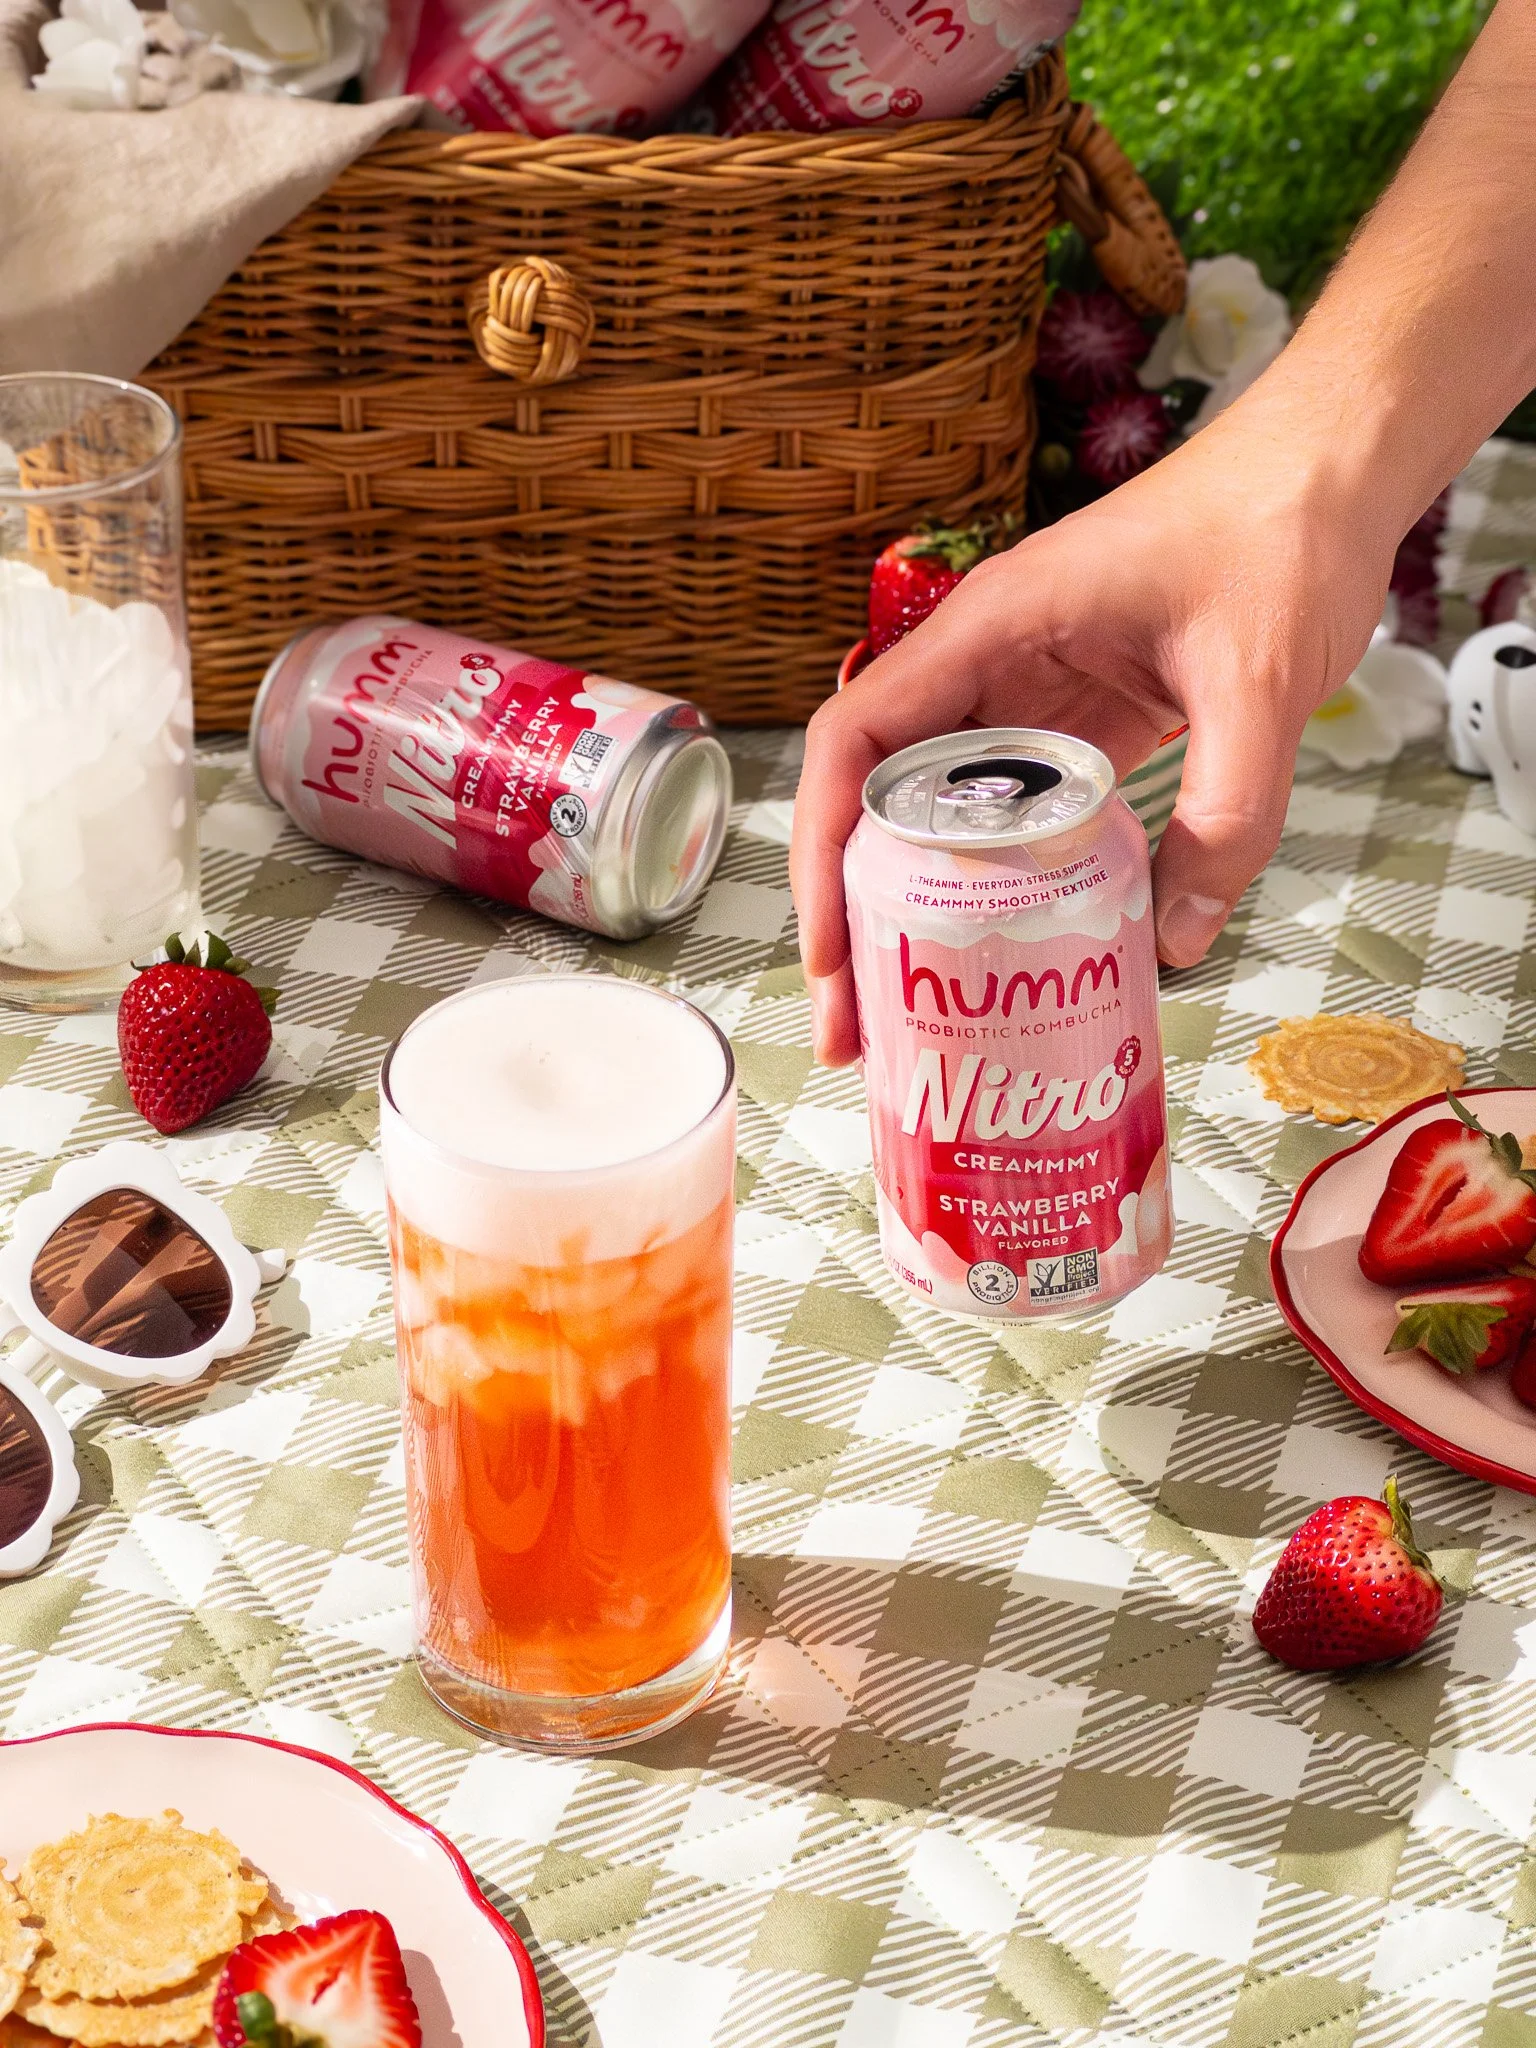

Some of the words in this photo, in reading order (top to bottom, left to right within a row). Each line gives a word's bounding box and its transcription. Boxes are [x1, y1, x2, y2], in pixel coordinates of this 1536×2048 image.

[302, 640, 419, 804] humm
[383, 667, 504, 850] Nitro
[496, 696, 560, 837] STRAWBERRY
[515, 723, 563, 812] VANILLA
[561, 808, 577, 824] 2
[972, 877, 1024, 891] EVERYDAY
[1026, 869, 1062, 885] STRESS
[1061, 853, 1100, 877] SUPPORT
[905, 892, 984, 909] CREAMMMY
[988, 890, 1051, 909] SMOOTH
[1052, 869, 1109, 899] TEXTURE
[900, 932, 1120, 1018] humm
[905, 1017, 1011, 1039] PROBIOTIC
[1020, 998, 1122, 1037] KOMBUCHA
[1123, 1048, 1135, 1067] 5
[901, 1047, 1127, 1143] Nitro
[953, 1149, 1100, 1175] CREAMMMY
[939, 1176, 1120, 1217] STRAWBERRY
[972, 1210, 1092, 1238] VANILLA
[998, 1235, 1069, 1250] FLAVORED
[972, 1263, 1011, 1278] BILLION
[1066, 1250, 1095, 1266] NON
[1066, 1260, 1096, 1275] GMO
[984, 1273, 1001, 1292] 2
[1034, 1278, 1097, 1296] VERIFIED
[1067, 1269, 1097, 1281] Project
